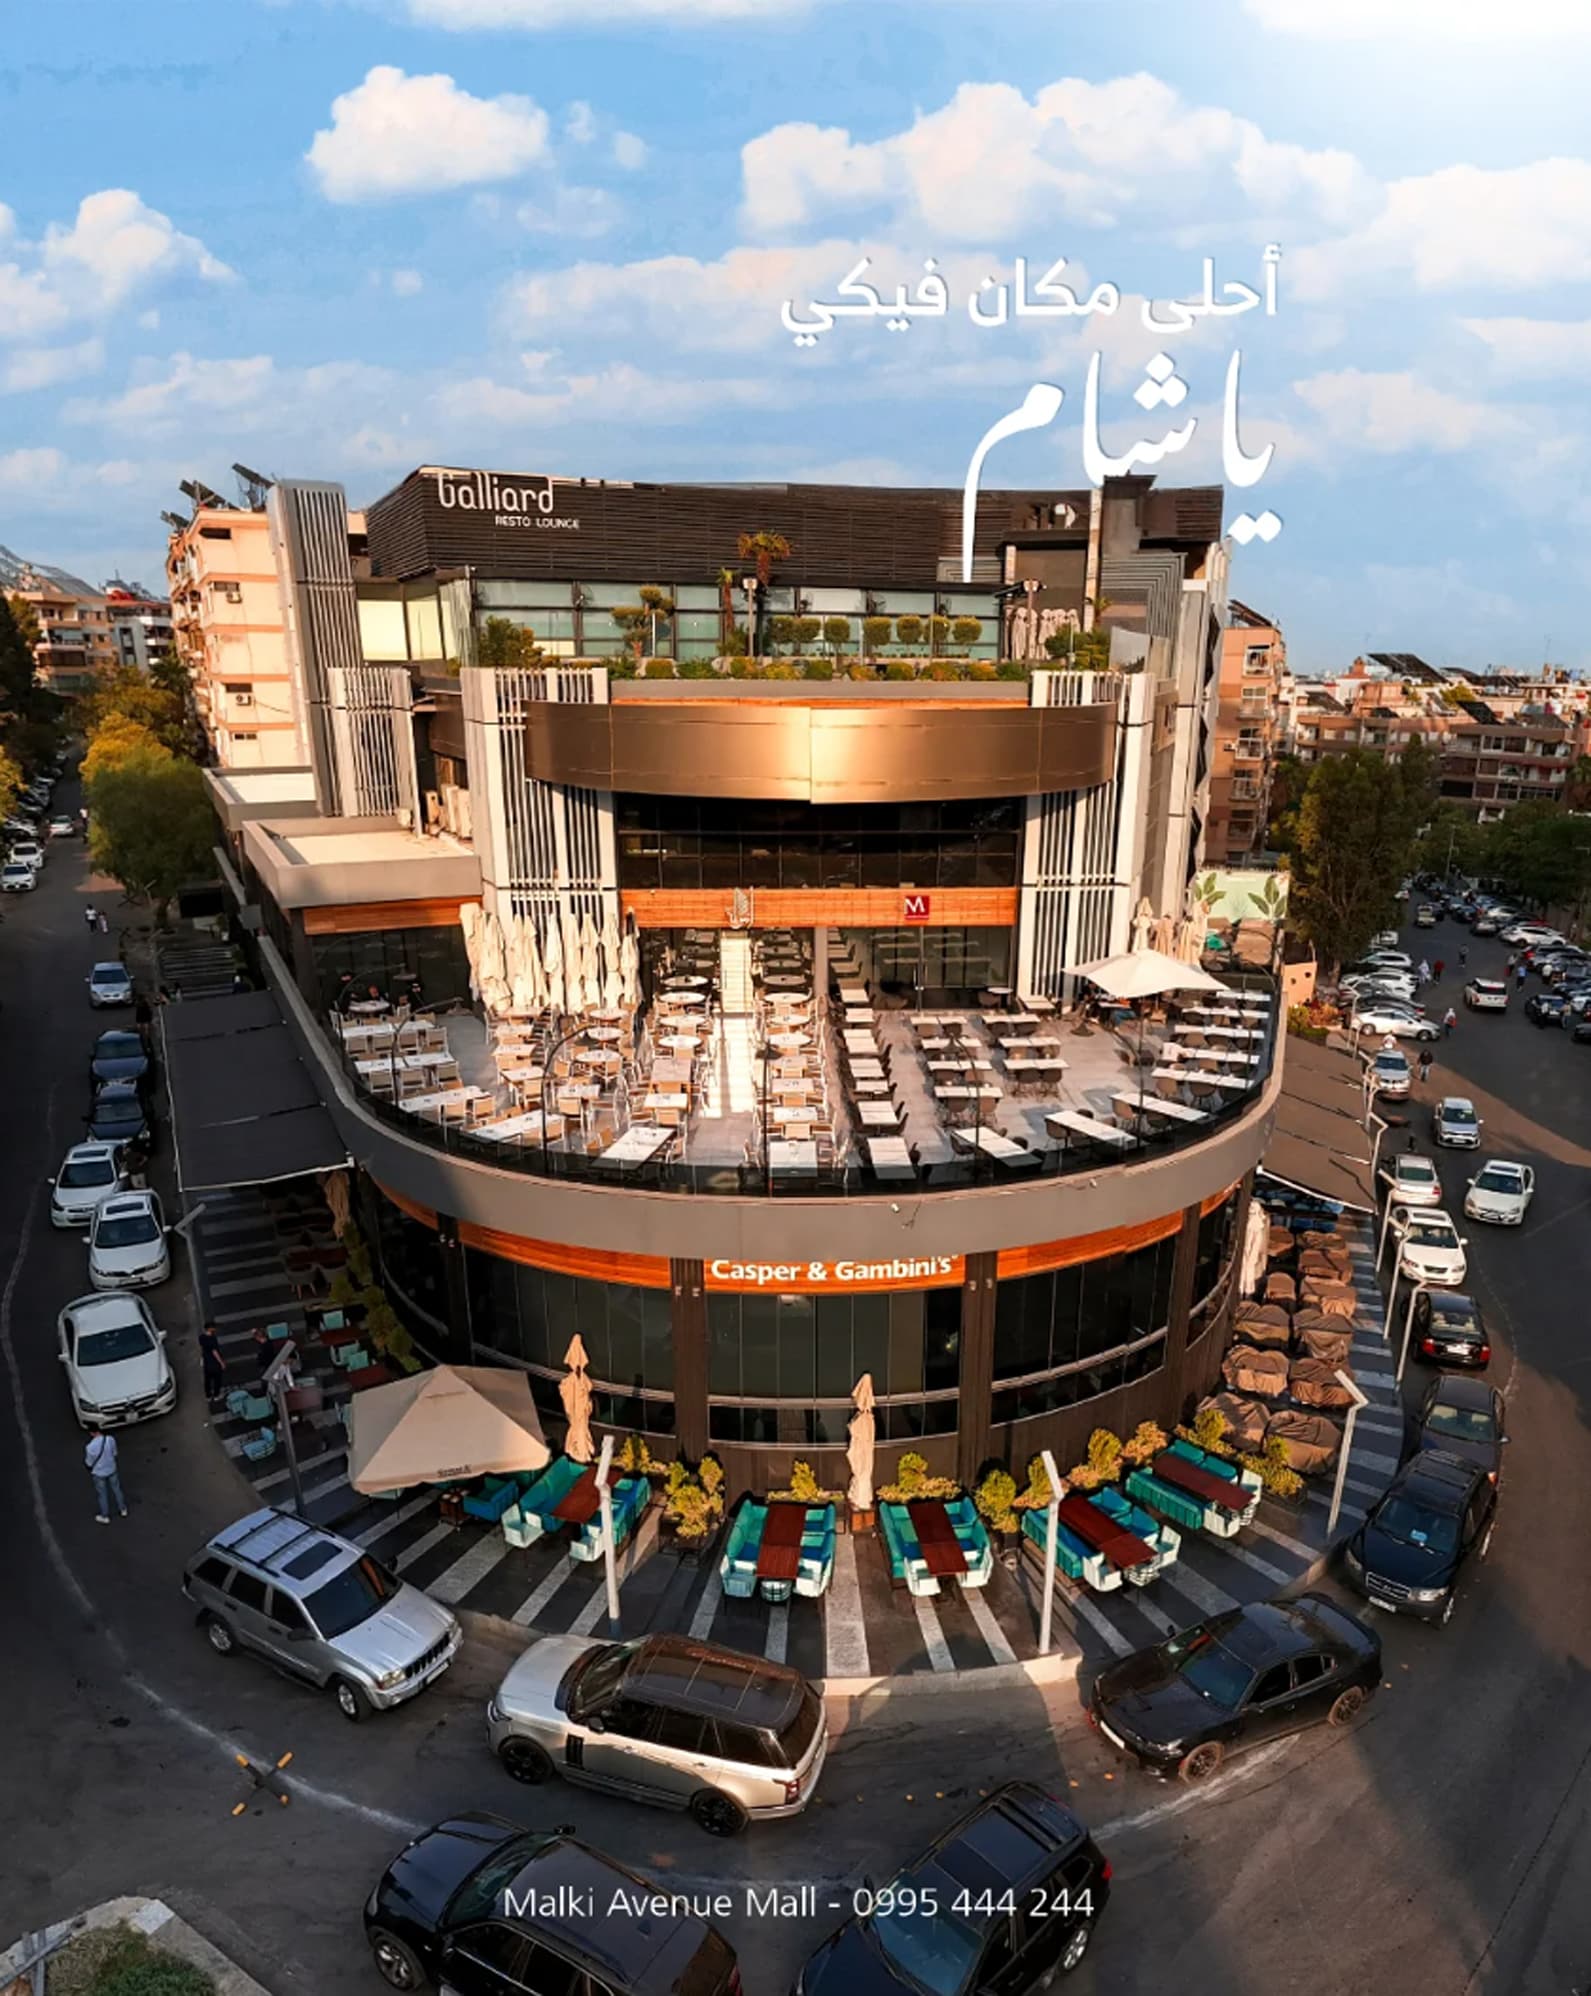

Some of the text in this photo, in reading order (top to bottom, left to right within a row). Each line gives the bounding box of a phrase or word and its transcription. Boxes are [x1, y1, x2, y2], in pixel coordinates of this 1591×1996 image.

[495, 515, 532, 528] RESTO
[711, 1256, 952, 1286] Casper & Gambini's
